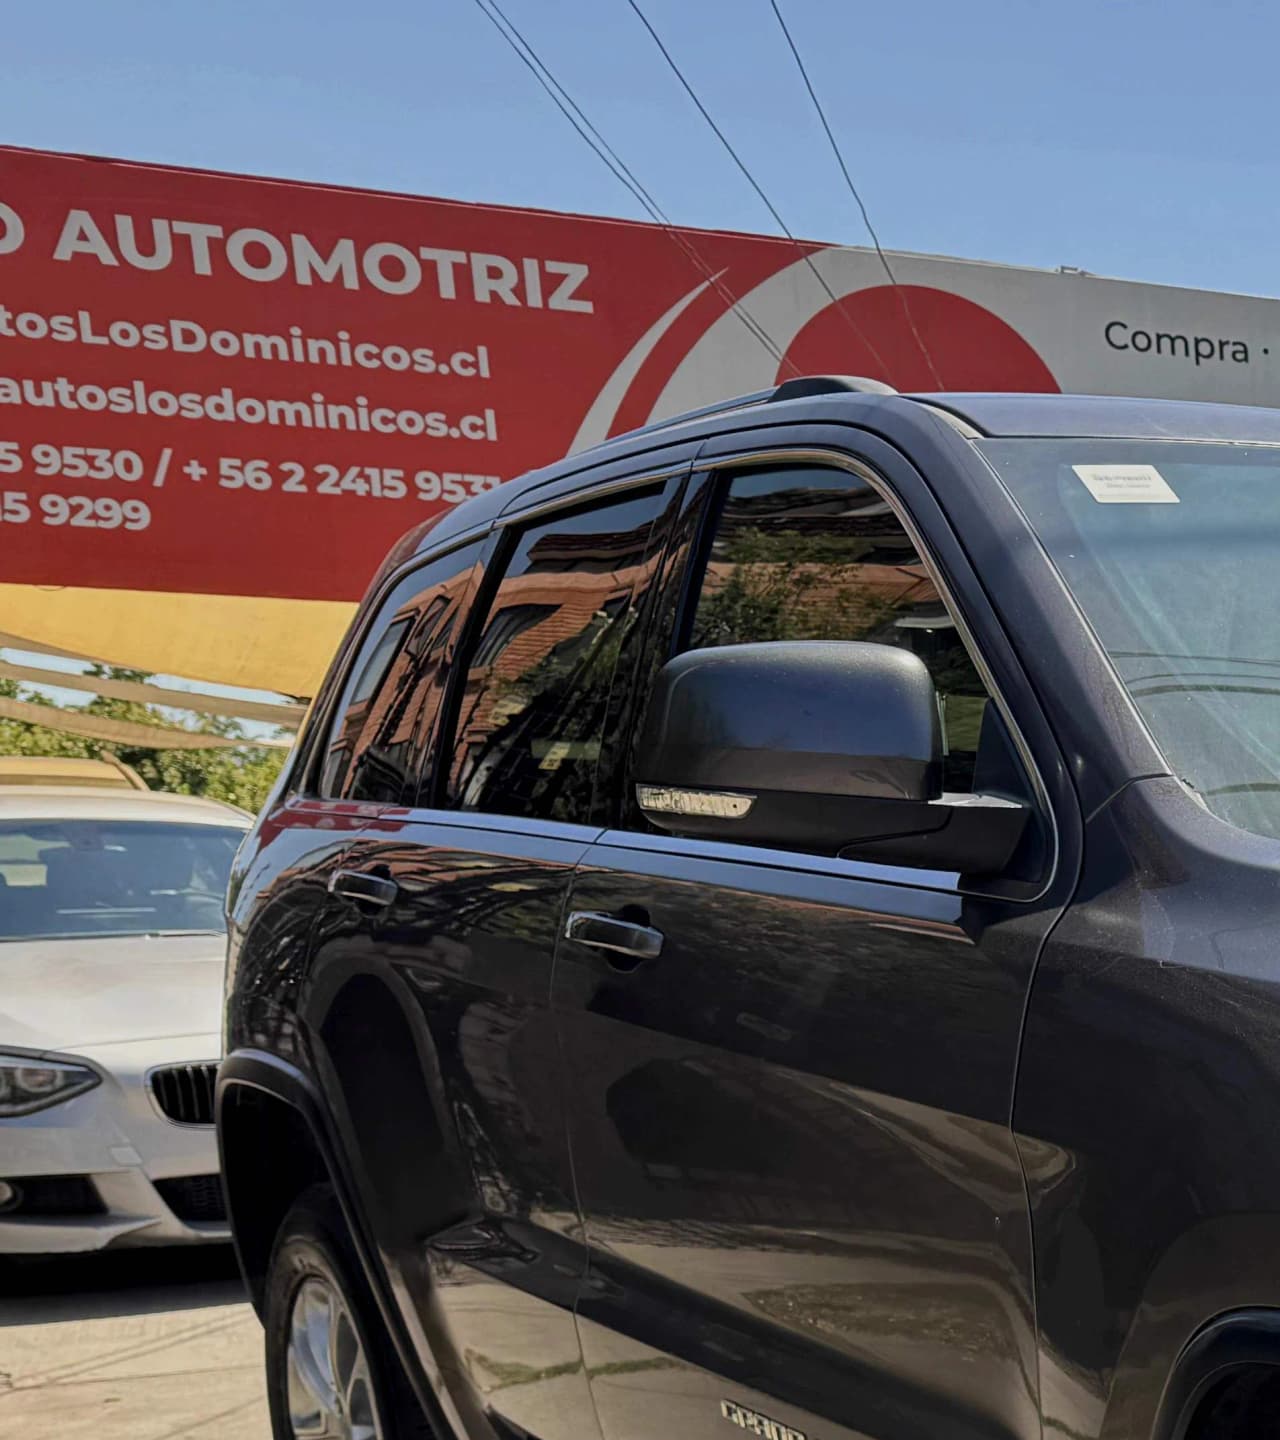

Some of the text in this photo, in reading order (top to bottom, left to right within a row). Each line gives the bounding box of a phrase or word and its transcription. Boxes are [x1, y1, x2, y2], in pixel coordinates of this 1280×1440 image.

[53, 208, 595, 315] AUTOMOTRIZ
[1103, 320, 1250, 366] Compra
[31, 443, 144, 481] 9530
[218, 457, 273, 491] 56
[278, 461, 308, 493] 2
[314, 464, 407, 500] 2415
[0, 491, 152, 530] 5 9299
